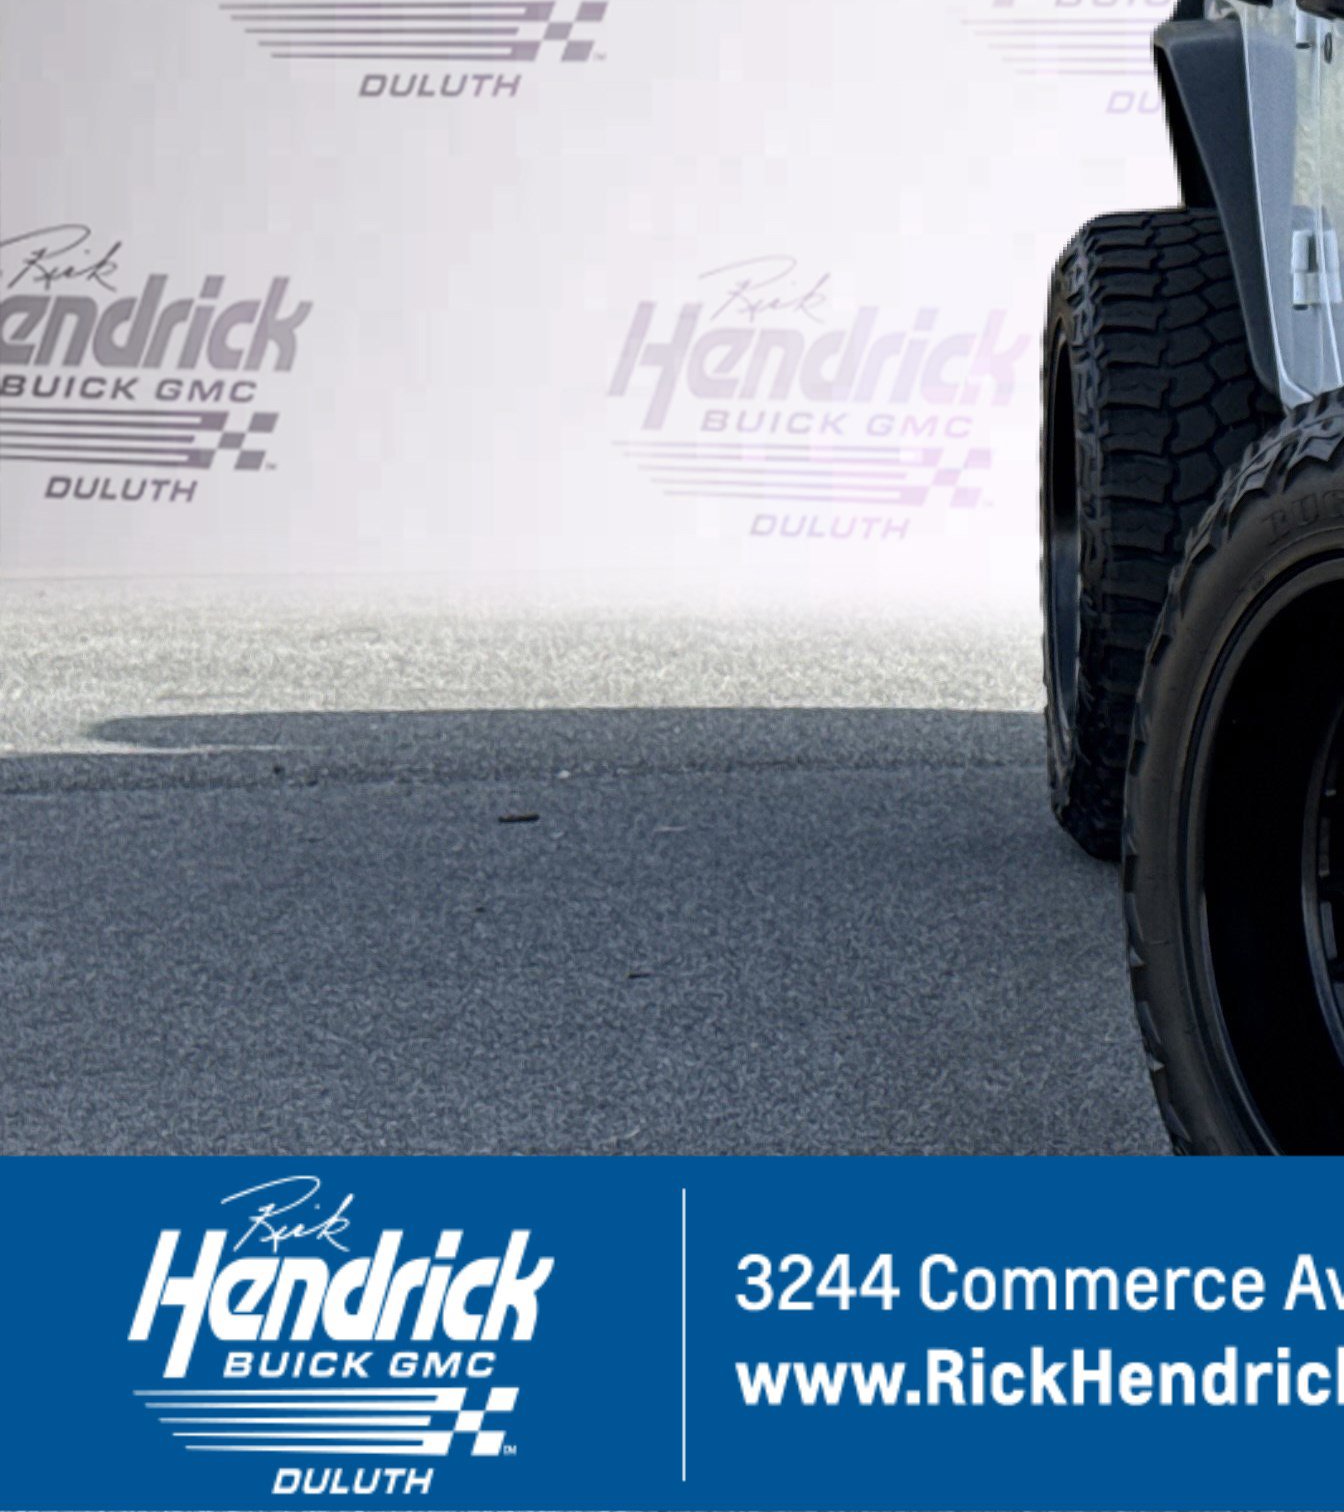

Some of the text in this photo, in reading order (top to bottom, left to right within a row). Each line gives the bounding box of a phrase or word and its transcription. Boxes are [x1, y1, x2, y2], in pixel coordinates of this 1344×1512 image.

[359, 74, 521, 97] DULUTH
[0, 274, 312, 371] endrick
[606, 301, 1031, 431] Hendrick
[0, 374, 256, 403] BUICK GMC
[700, 409, 973, 439] BUICK GMC
[45, 476, 198, 502] DULUTH
[748, 513, 910, 539] DULUTH
